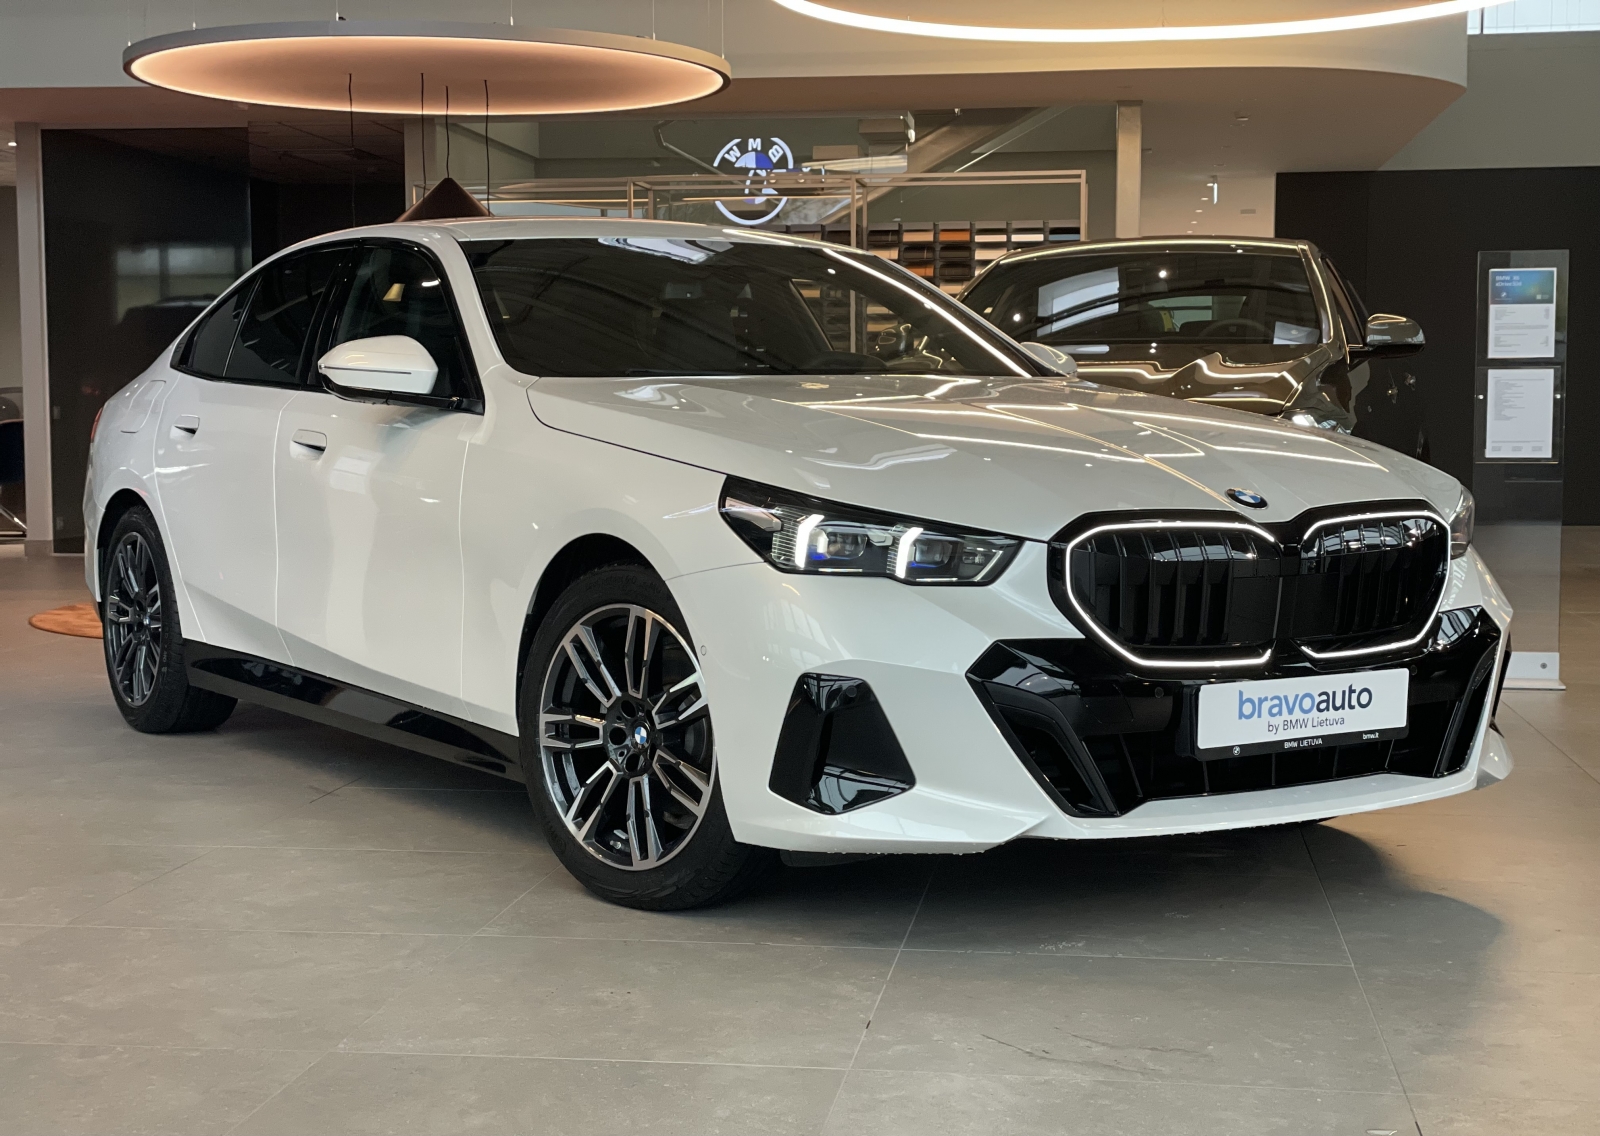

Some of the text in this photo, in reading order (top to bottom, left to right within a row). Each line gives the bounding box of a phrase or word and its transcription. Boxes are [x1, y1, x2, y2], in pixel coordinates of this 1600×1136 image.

[1238, 683, 1373, 720] bravoauto
[1267, 716, 1345, 735] by BMW Lietuva
[1284, 738, 1323, 749] BMW LIETUVA
[1362, 732, 1379, 740] bmw.lt
